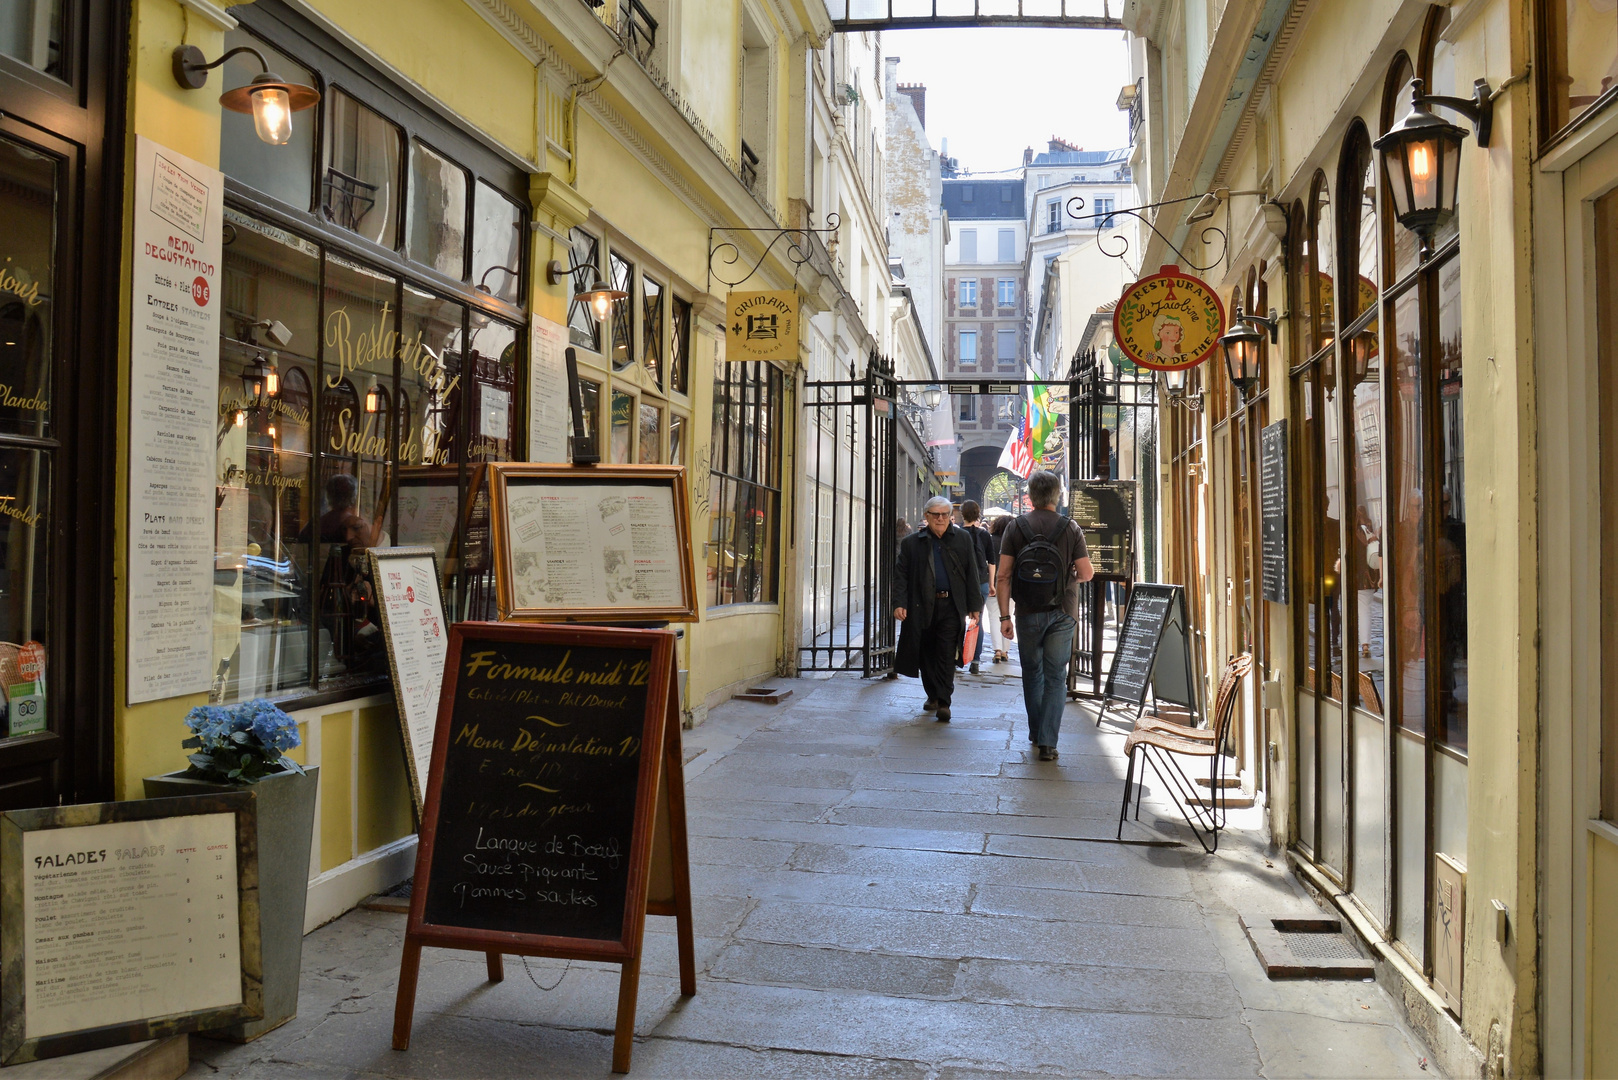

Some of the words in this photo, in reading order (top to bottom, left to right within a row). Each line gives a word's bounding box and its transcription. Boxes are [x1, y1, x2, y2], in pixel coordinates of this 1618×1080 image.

[167, 234, 194, 255] MENU
[145, 242, 214, 277] DEGUSTATION
[179, 280, 190, 293] Plat
[734, 295, 792, 317] GRIMART
[1136, 303, 1152, 322] La
[1151, 298, 1200, 322] Jacobine
[325, 300, 461, 407] Restaurant
[742, 342, 783, 354] HANDMADE
[1172, 354, 1188, 364] DE
[1191, 336, 1214, 357] THE
[0, 384, 48, 411] Plancha
[330, 408, 388, 458] Salon
[399, 427, 418, 462] de
[218, 457, 253, 484] Soe
[0, 495, 42, 528] hocolat
[144, 512, 165, 523] PLATS
[21, 662, 38, 674] yelp
[466, 650, 574, 684] Formule
[576, 659, 627, 686] midi
[628, 660, 650, 686] 12
[454, 723, 506, 750] Menu
[34, 849, 106, 869] SALADES
[114, 844, 165, 861] SALADS
[475, 827, 538, 862] Langue
[545, 835, 565, 855] de
[34, 870, 77, 881] Végétarienne
[464, 854, 513, 875] Sauce
[34, 892, 63, 902] Montagne
[35, 956, 58, 964] Maison
[35, 976, 65, 986] Maritime
